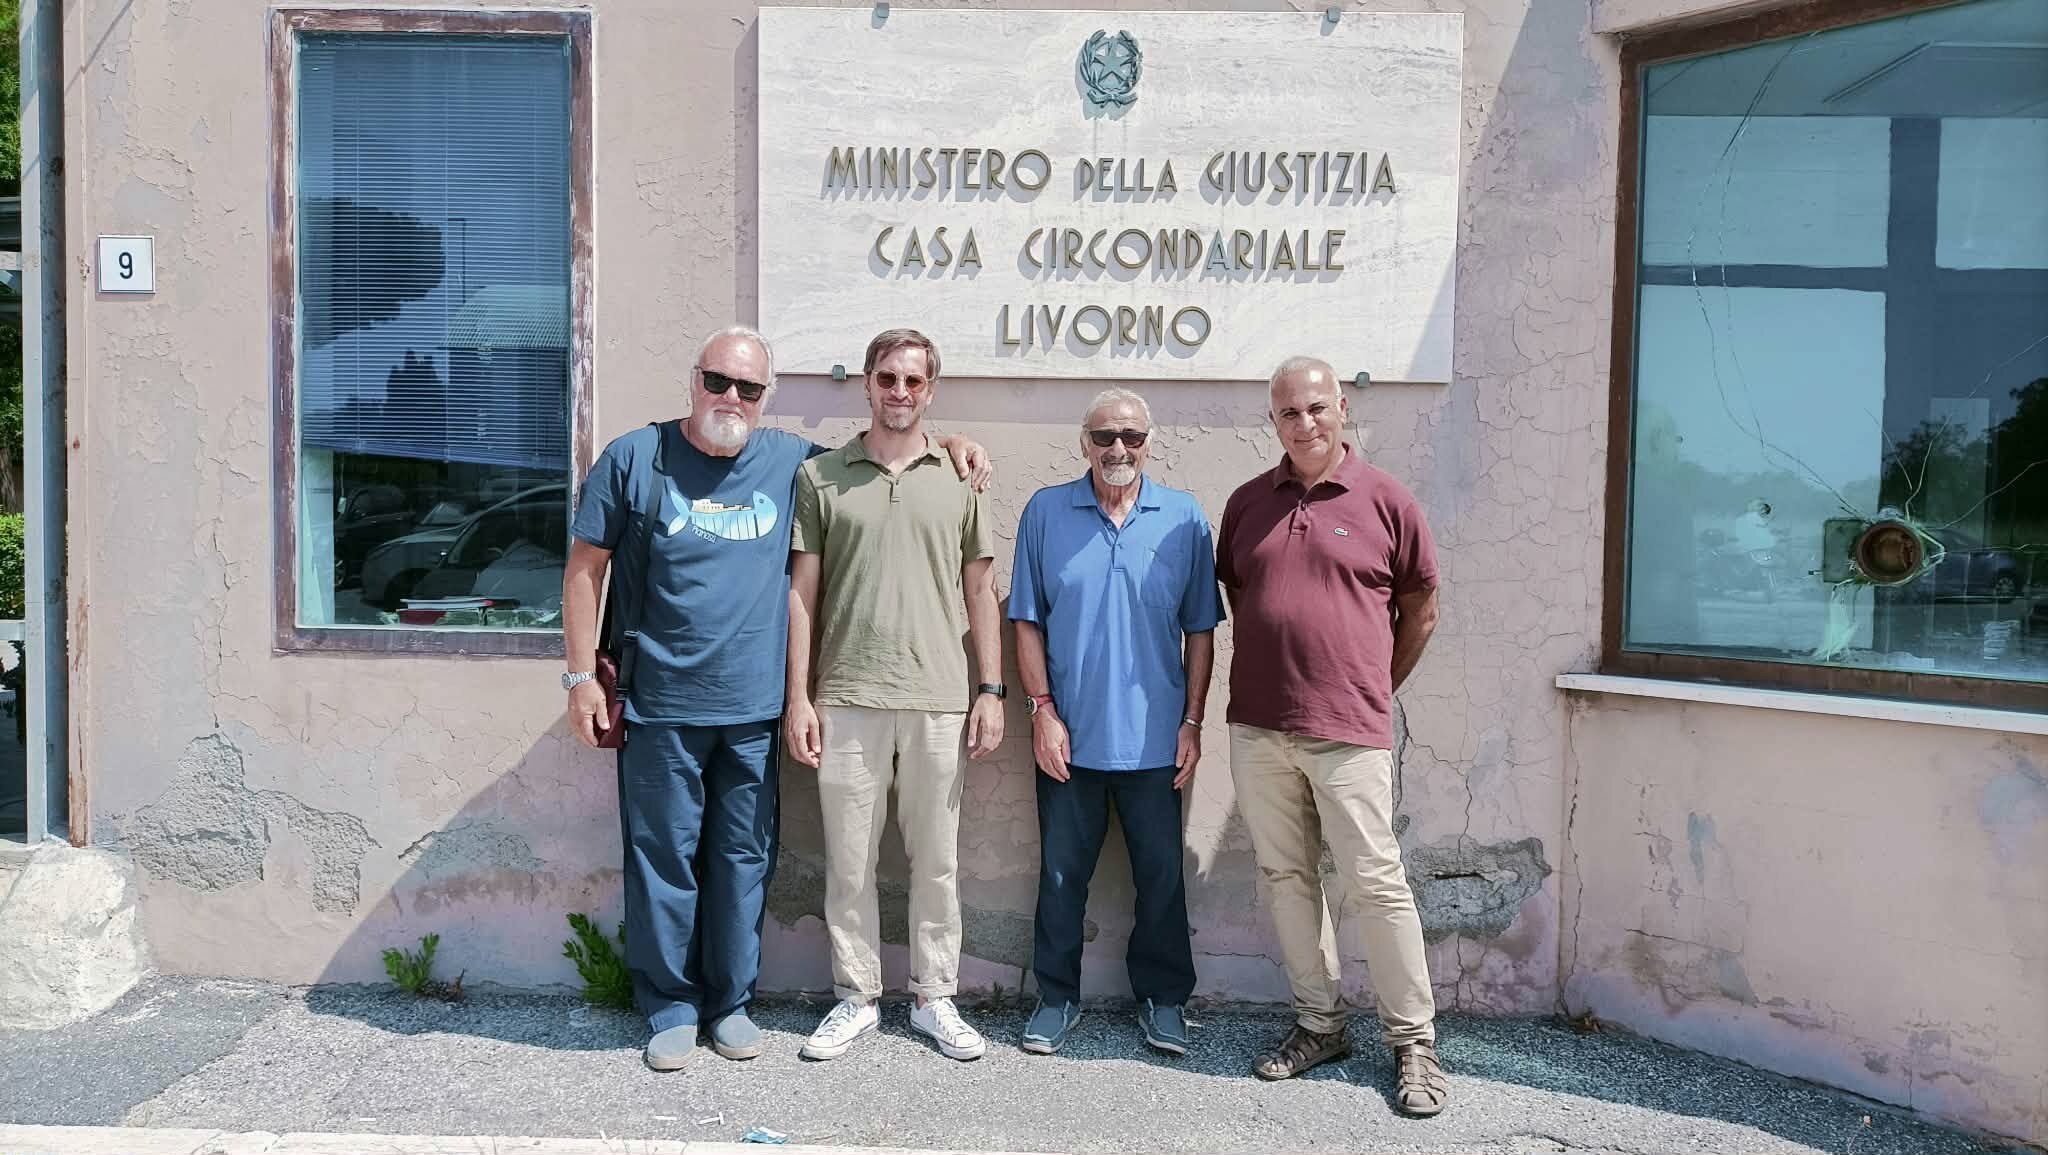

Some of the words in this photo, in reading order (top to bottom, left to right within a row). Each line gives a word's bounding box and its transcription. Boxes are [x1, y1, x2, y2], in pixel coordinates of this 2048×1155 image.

[828, 147, 1051, 190] MINISTERO
[1079, 157, 1178, 192] DELLA
[1206, 151, 1396, 193] GIUSTIZIA
[119, 252, 132, 279] 9
[876, 226, 982, 267] CASA
[1024, 228, 1346, 270] CIRCONDARIALE
[1003, 305, 1211, 345] LIVORNO
